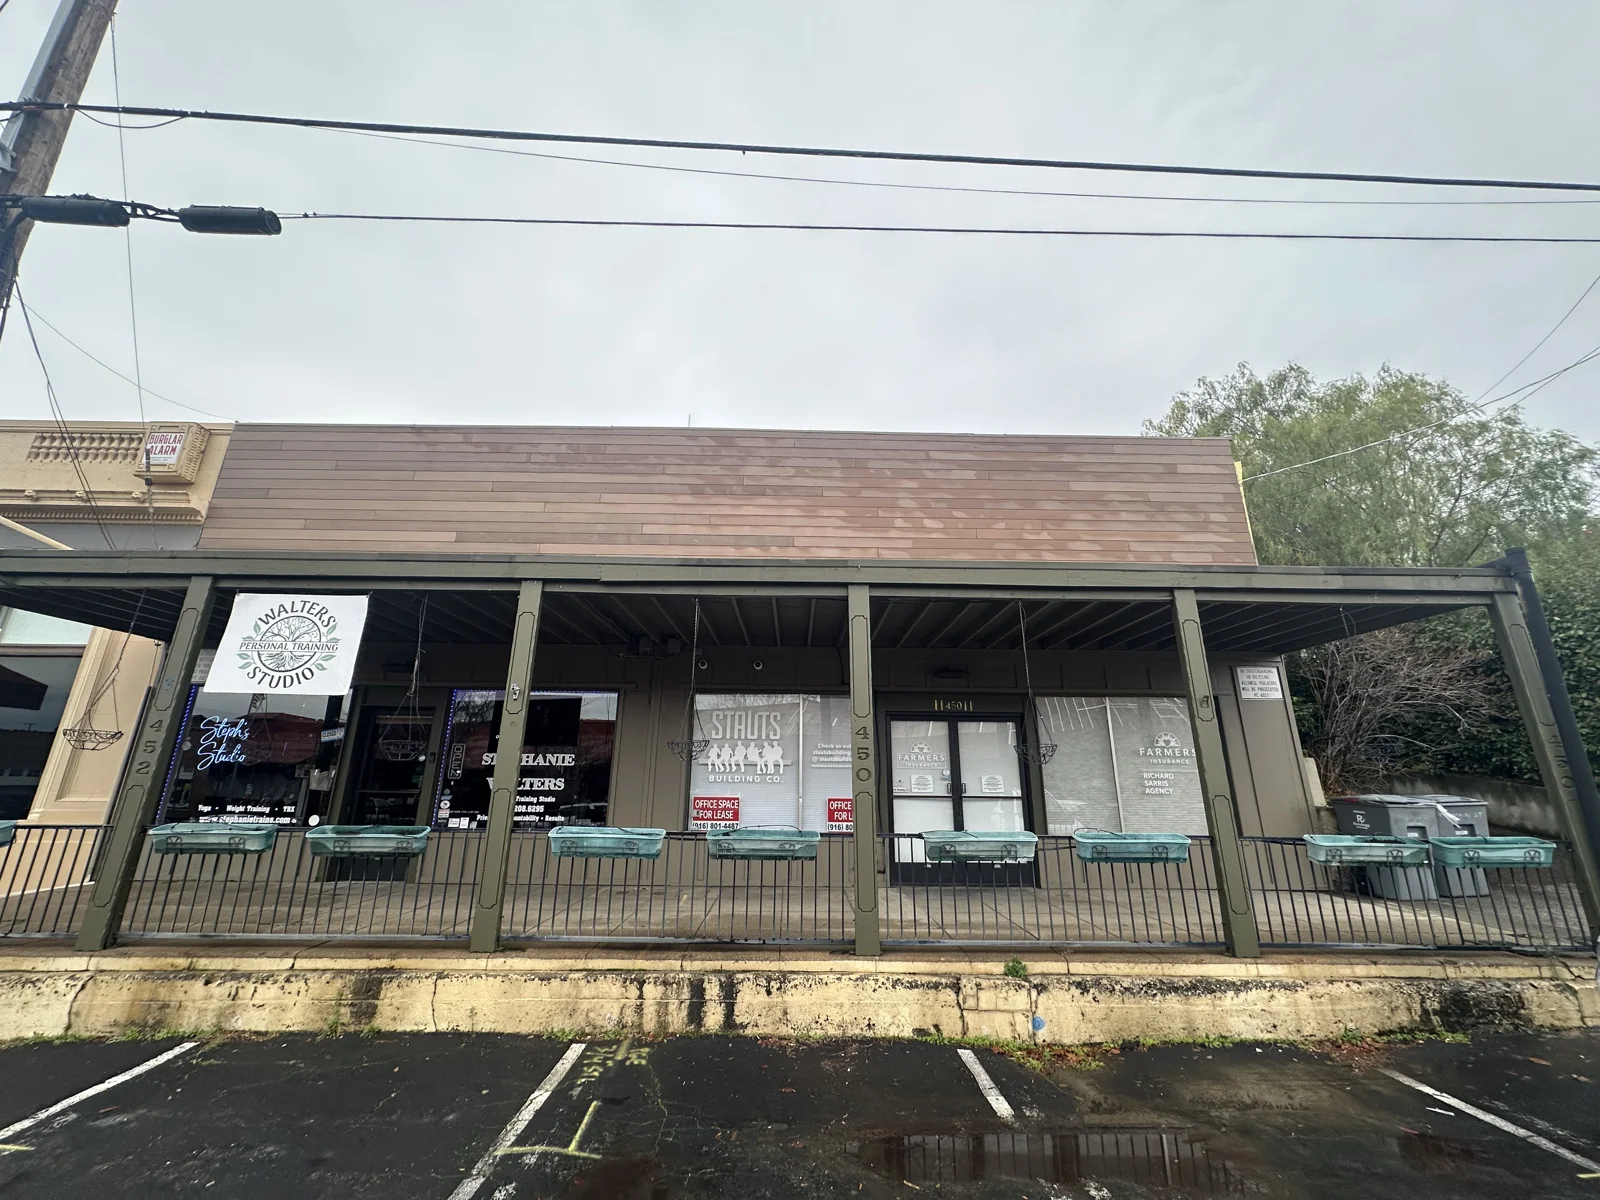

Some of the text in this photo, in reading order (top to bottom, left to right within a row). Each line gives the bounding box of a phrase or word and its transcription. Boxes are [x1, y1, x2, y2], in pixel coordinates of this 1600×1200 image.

[149, 434, 184, 444] BURGLAR
[149, 445, 178, 456] ALARM
[257, 600, 336, 628] WALTERS
[239, 641, 339, 651] PERSONAL TRAINING
[246, 666, 315, 689] STUDIO
[200, 716, 250, 744] Steph's
[711, 710, 781, 740] STAUTS
[197, 742, 246, 770] Studio
[854, 726, 872, 782] 450
[1139, 748, 1197, 757] FARMERS
[449, 745, 463, 777] OPEN
[481, 753, 576, 766] STHANIE
[898, 754, 945, 762] FARMERS
[486, 777, 565, 790] LTERS
[766, 775, 785, 783] CO.
[515, 795, 538, 804] Training
[694, 799, 739, 809] OFFICE SPACE
[226, 804, 245, 813] Weight
[246, 804, 271, 814] Training
[829, 801, 852, 810] OFFICE
[198, 815, 291, 824] w.stephanietrains.com
[699, 810, 734, 819] FOR LEASE
[834, 811, 848, 820] FOR
[692, 822, 739, 830] (916) 801-4487
[827, 823, 844, 831] (916)
